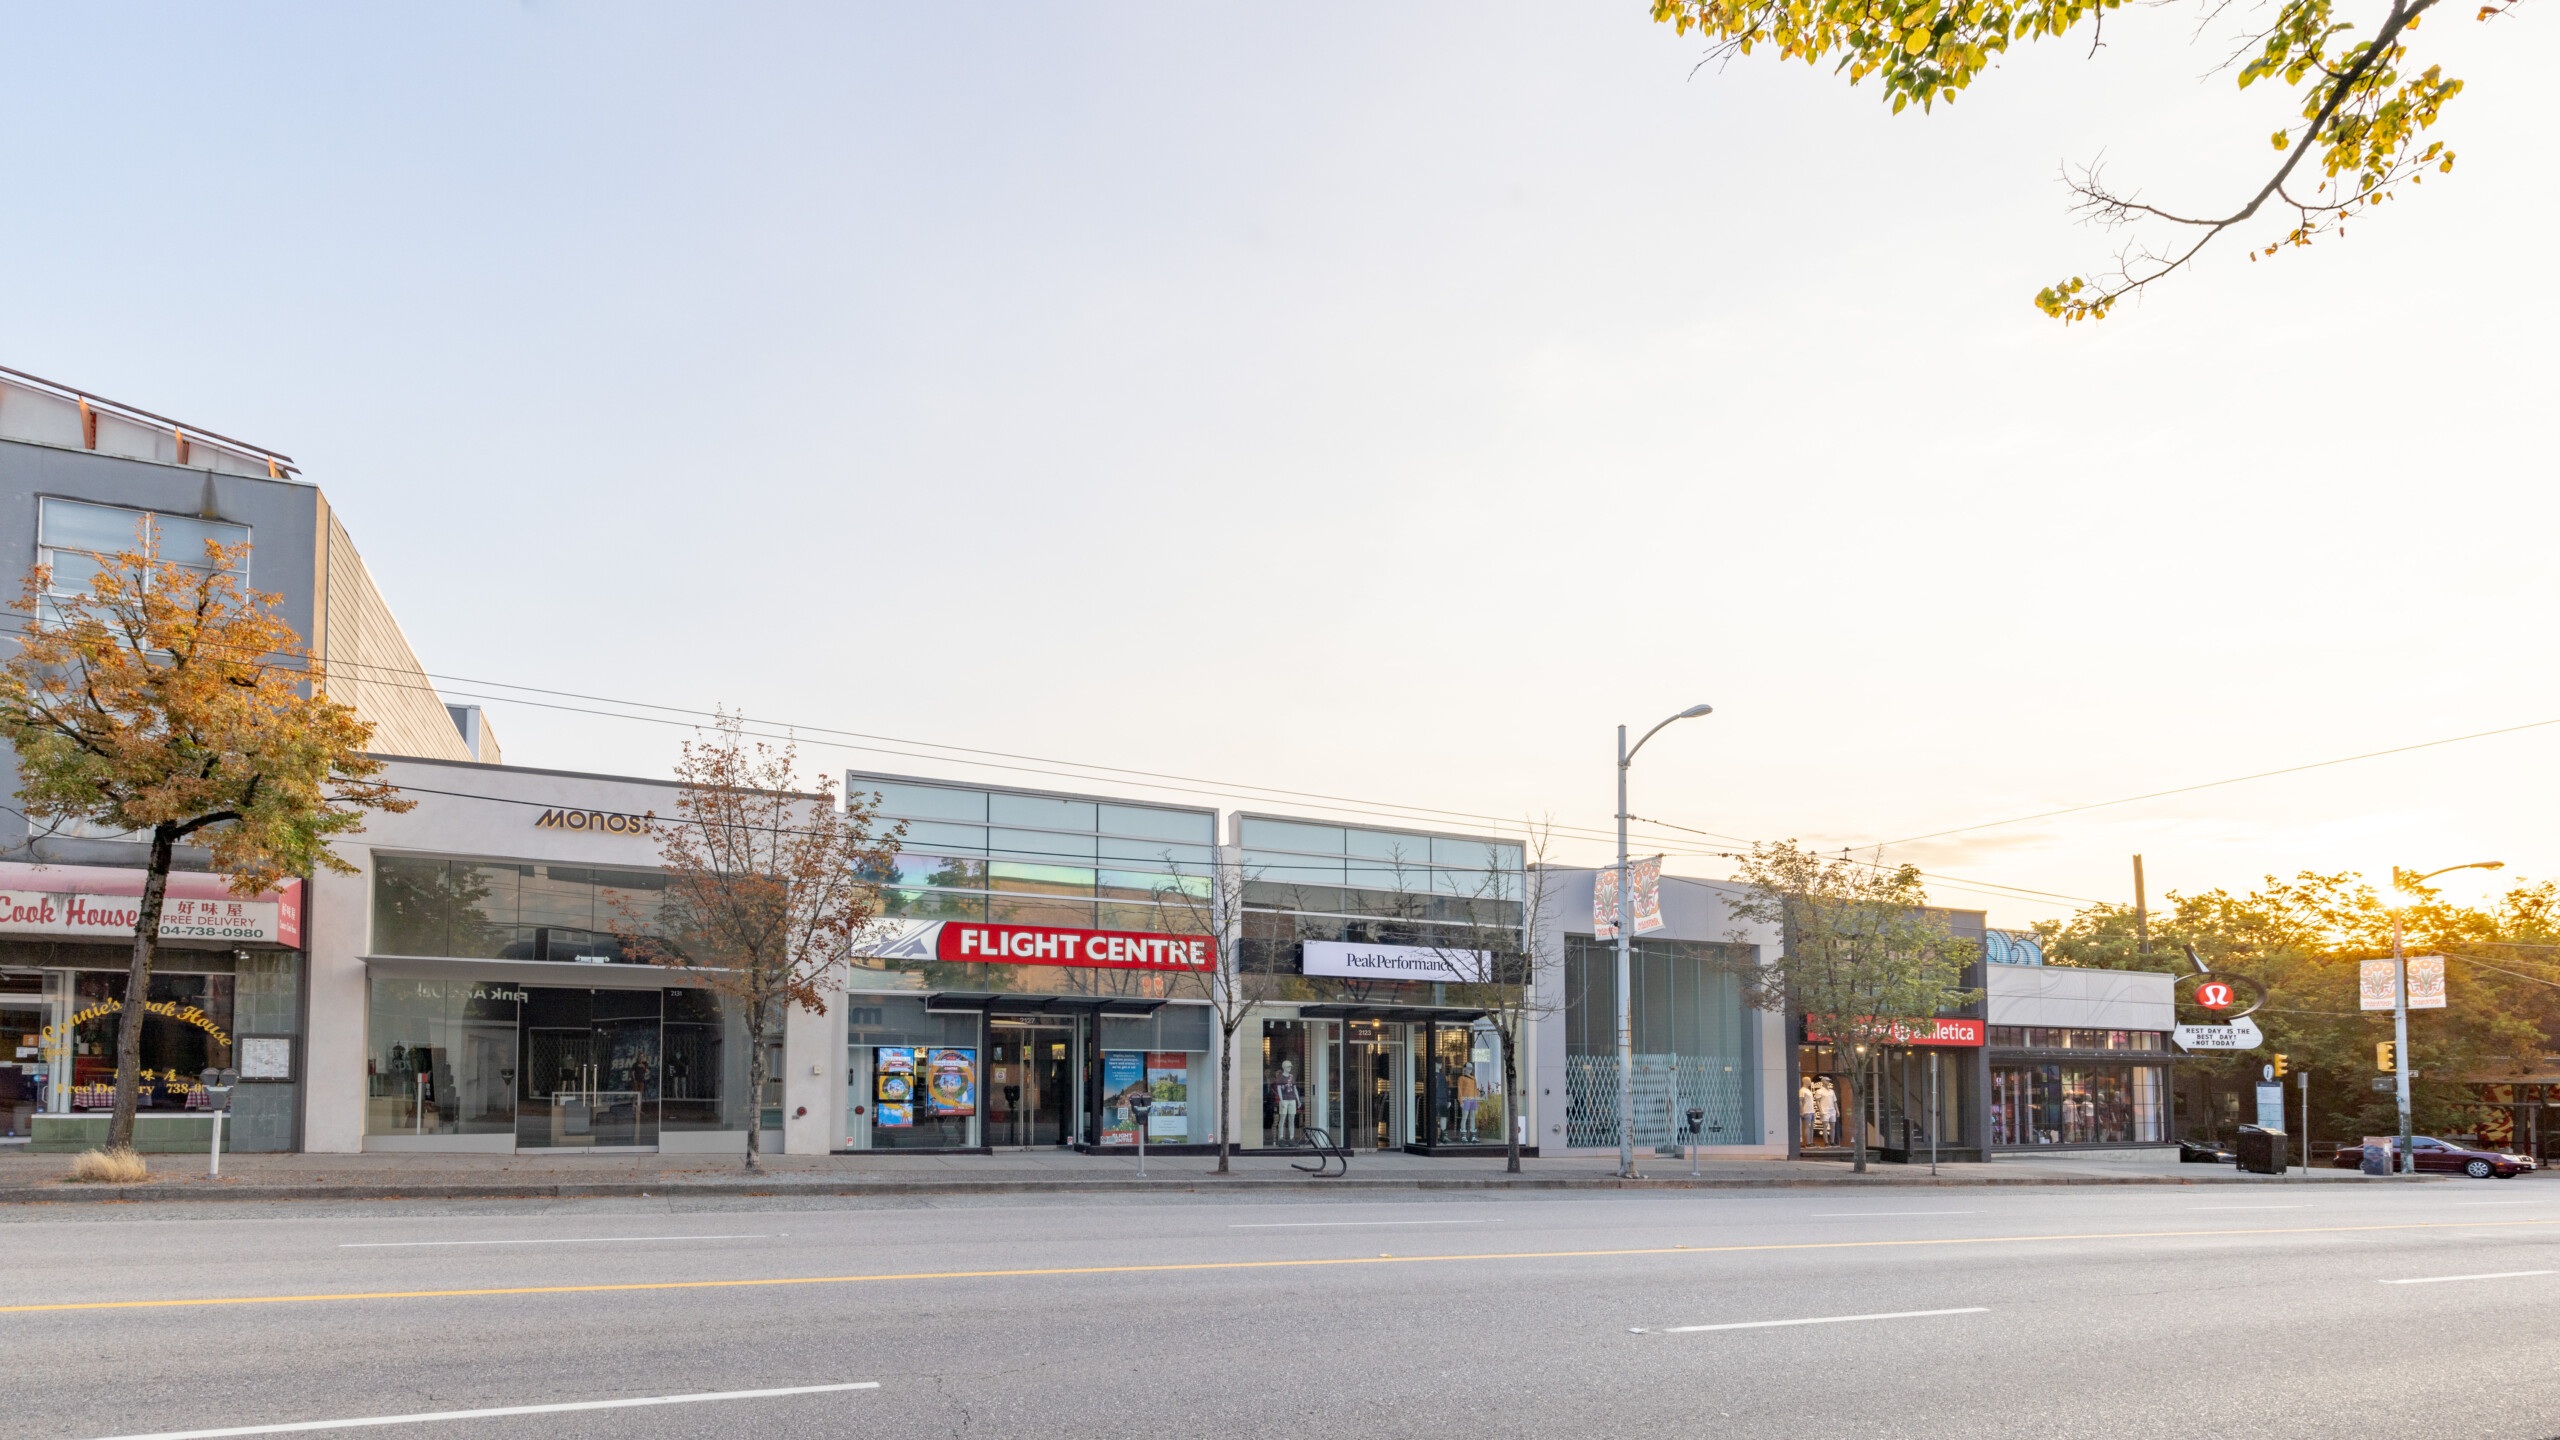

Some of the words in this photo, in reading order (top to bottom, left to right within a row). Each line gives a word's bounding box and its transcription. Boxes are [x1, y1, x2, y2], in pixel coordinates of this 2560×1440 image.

[66, 898, 138, 927] House
[178, 901, 243, 916] 好味屋
[160, 925, 264, 938] 04-738-0980
[162, 915, 192, 925] FREE
[197, 916, 256, 927] DELIVERY
[960, 929, 1081, 959] FLIGHT
[1085, 936, 1205, 965] CENTRE
[42, 997, 122, 1043] Connie's
[177, 1005, 232, 1047] House
